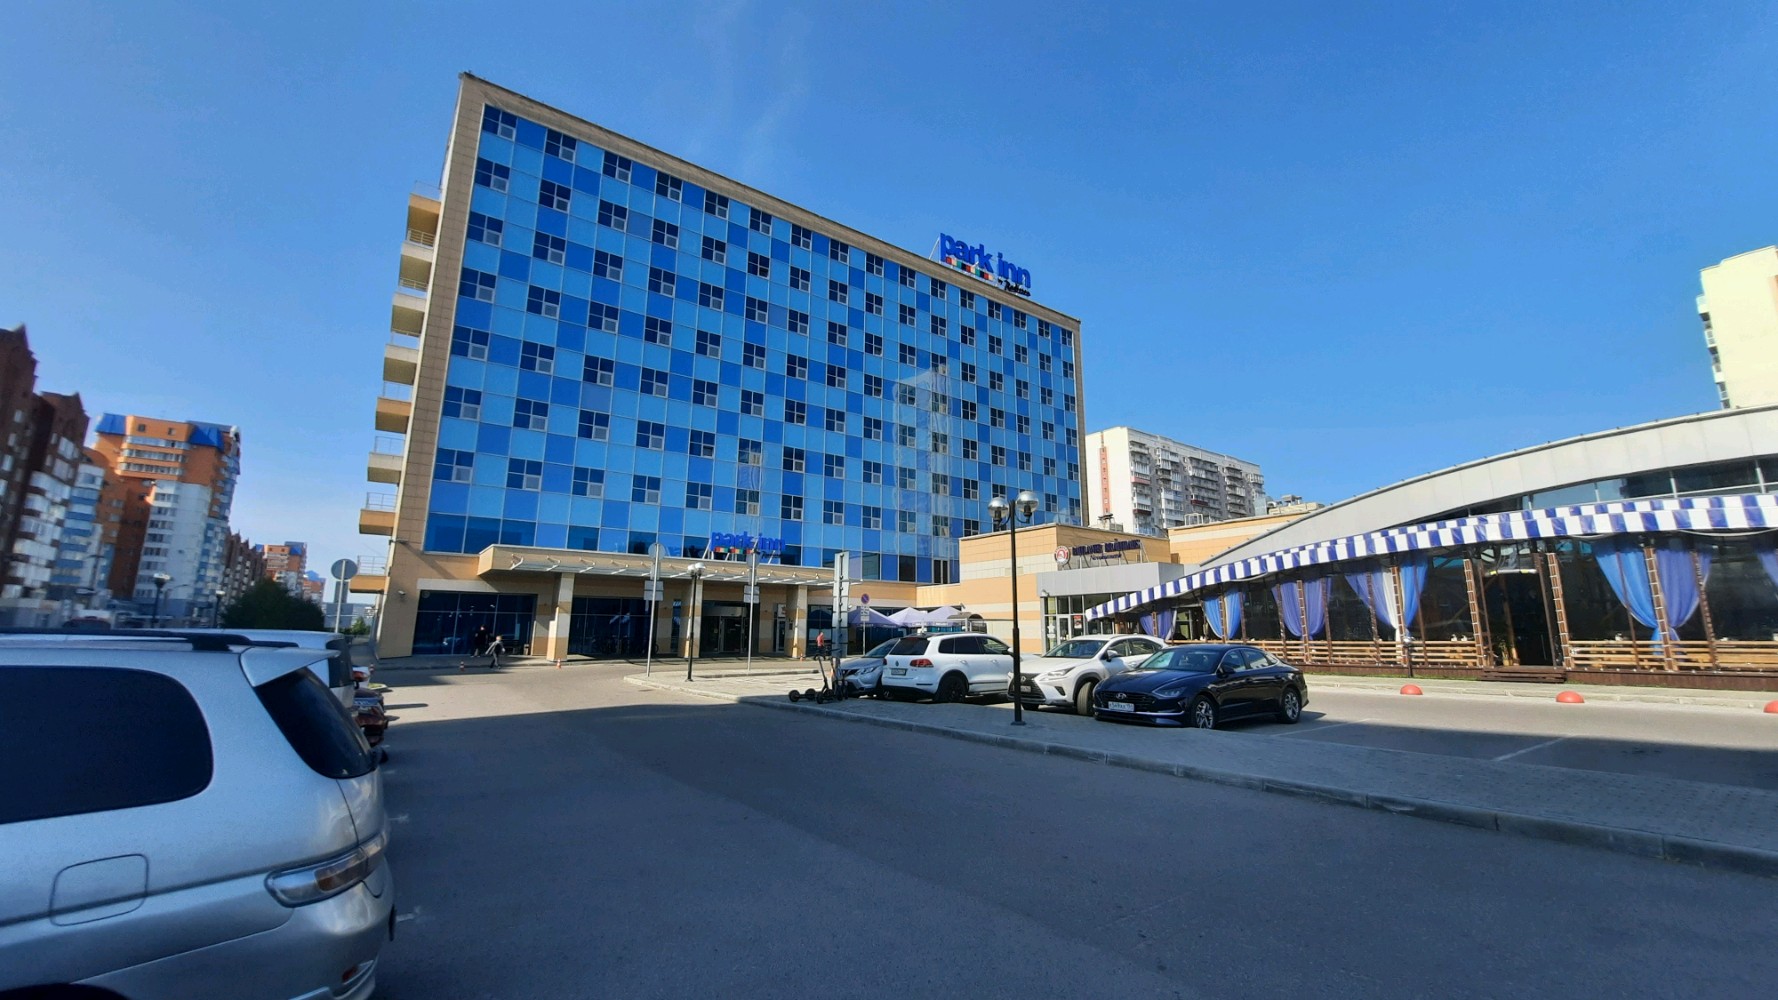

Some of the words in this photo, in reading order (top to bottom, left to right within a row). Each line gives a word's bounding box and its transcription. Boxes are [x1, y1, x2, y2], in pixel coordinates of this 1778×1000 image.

[940, 232, 994, 273] park
[997, 251, 1031, 289] inn
[710, 531, 755, 552] park
[758, 532, 786, 552] inn
